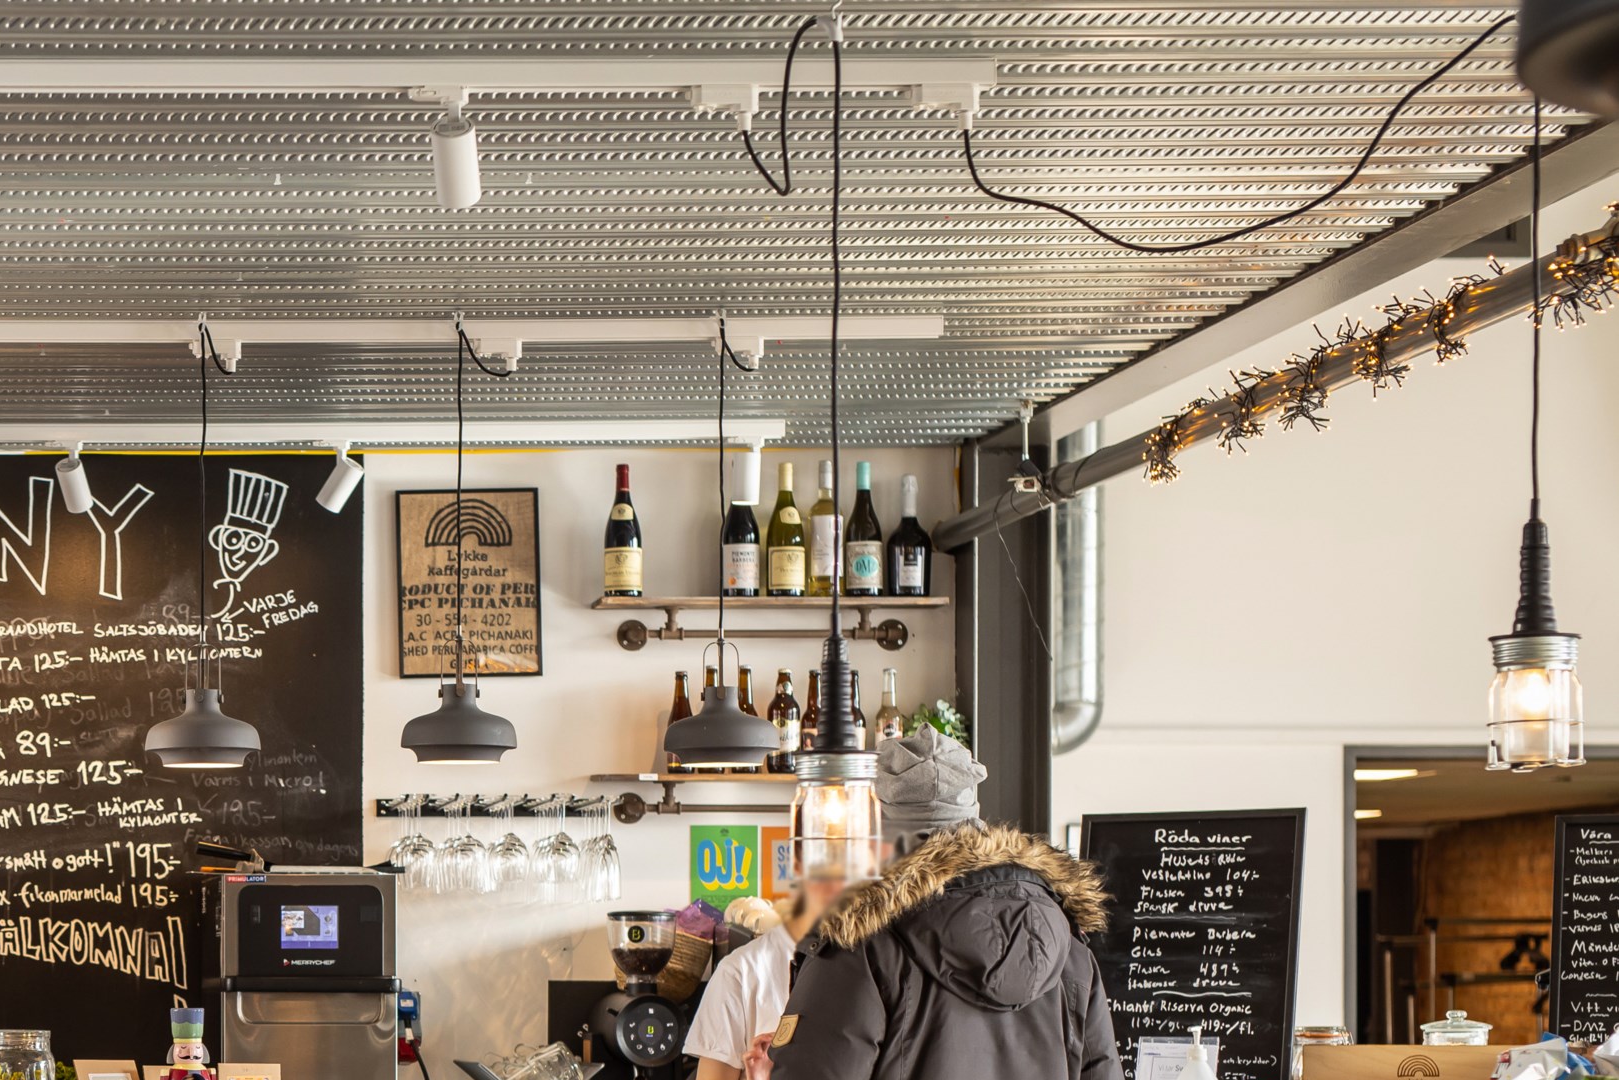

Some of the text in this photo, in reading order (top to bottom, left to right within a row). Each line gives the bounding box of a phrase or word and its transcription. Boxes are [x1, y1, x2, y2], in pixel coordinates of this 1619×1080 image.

[402, 582, 536, 598] RODUCT OF PER
[243, 589, 297, 614] VARJE
[437, 597, 538, 610] PICHANAK
[262, 601, 319, 629] FREDAG
[480, 613, 512, 626] 4202
[216, 623, 266, 642] 125:-
[403, 645, 428, 657] SHED
[33, 650, 83, 673] 125:-
[89, 647, 147, 664] HÄMTAS
[41, 692, 97, 708] 125:-
[15, 731, 71, 758] 89:-
[76, 760, 144, 786] 125:-
[27, 803, 87, 826] 125:-
[97, 797, 165, 817] HÄMTAS
[1154, 828, 1252, 844] Röda viner
[1209, 1002, 1253, 1016] Organic
